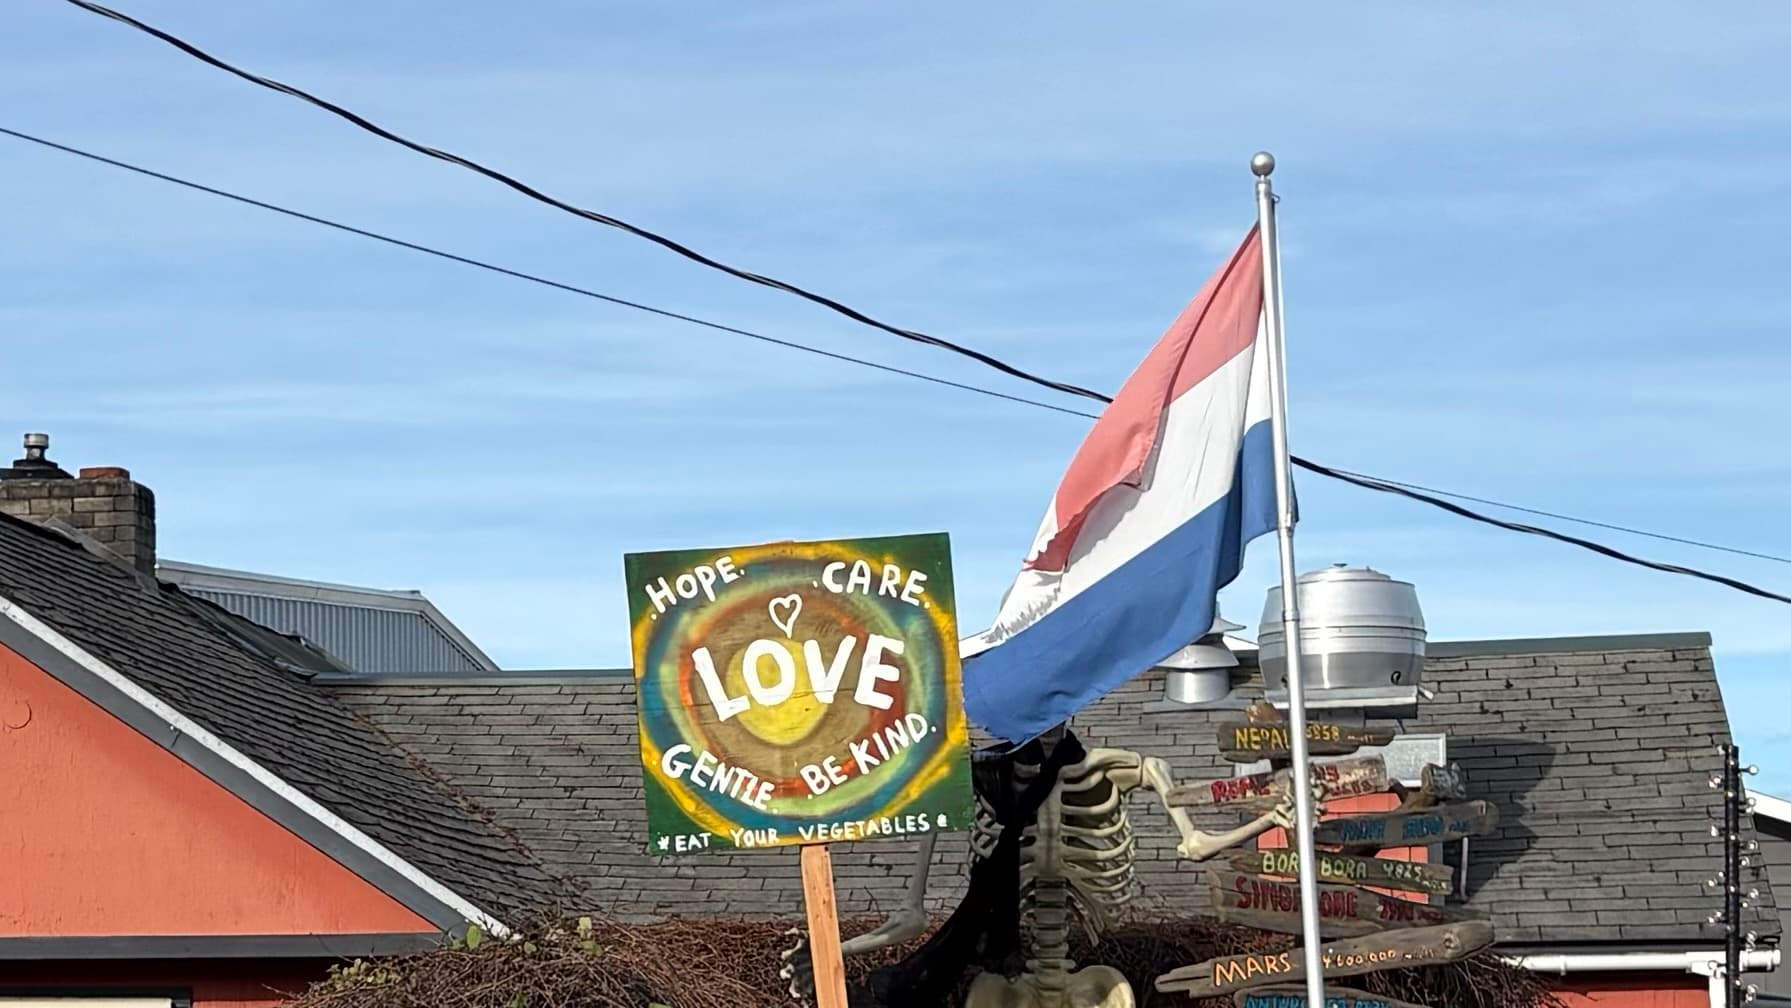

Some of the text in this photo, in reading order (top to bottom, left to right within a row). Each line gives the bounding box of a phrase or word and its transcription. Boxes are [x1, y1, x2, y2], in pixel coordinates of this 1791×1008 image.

[692, 634, 905, 722] LOVE
[799, 756, 848, 797] BE
[730, 827, 781, 848] YOUR
[798, 813, 931, 841] VEGETABLES
[1262, 852, 1300, 873] BOR
[1320, 857, 1367, 879] BORA
[1214, 952, 1292, 986] MARS
